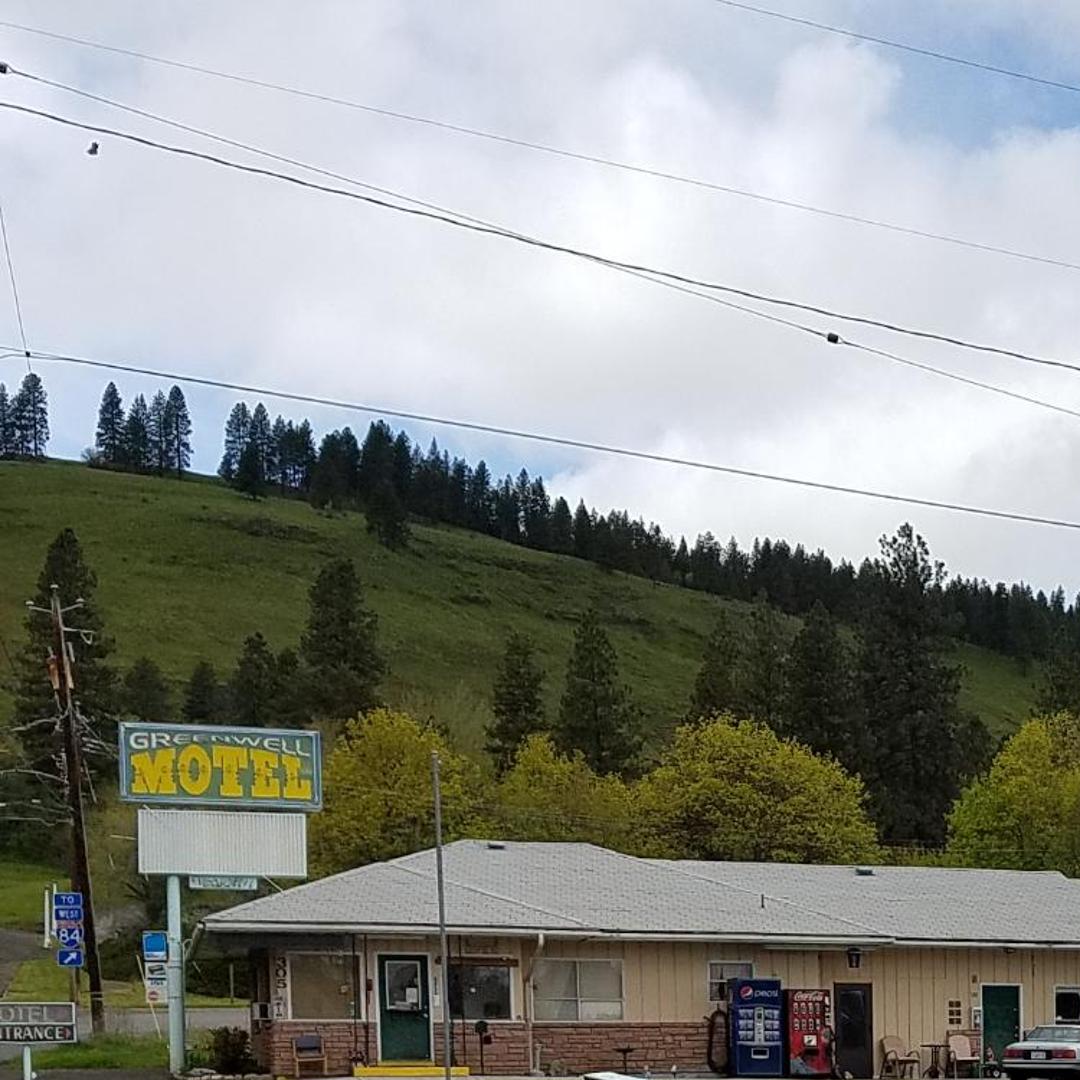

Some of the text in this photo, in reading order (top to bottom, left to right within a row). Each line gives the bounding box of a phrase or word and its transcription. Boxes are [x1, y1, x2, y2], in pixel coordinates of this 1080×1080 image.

[130, 743, 313, 800] MOTEL
[60, 895, 75, 905] TO
[60, 928, 80, 944] 84
[0, 1026, 65, 1040] TRANCE
